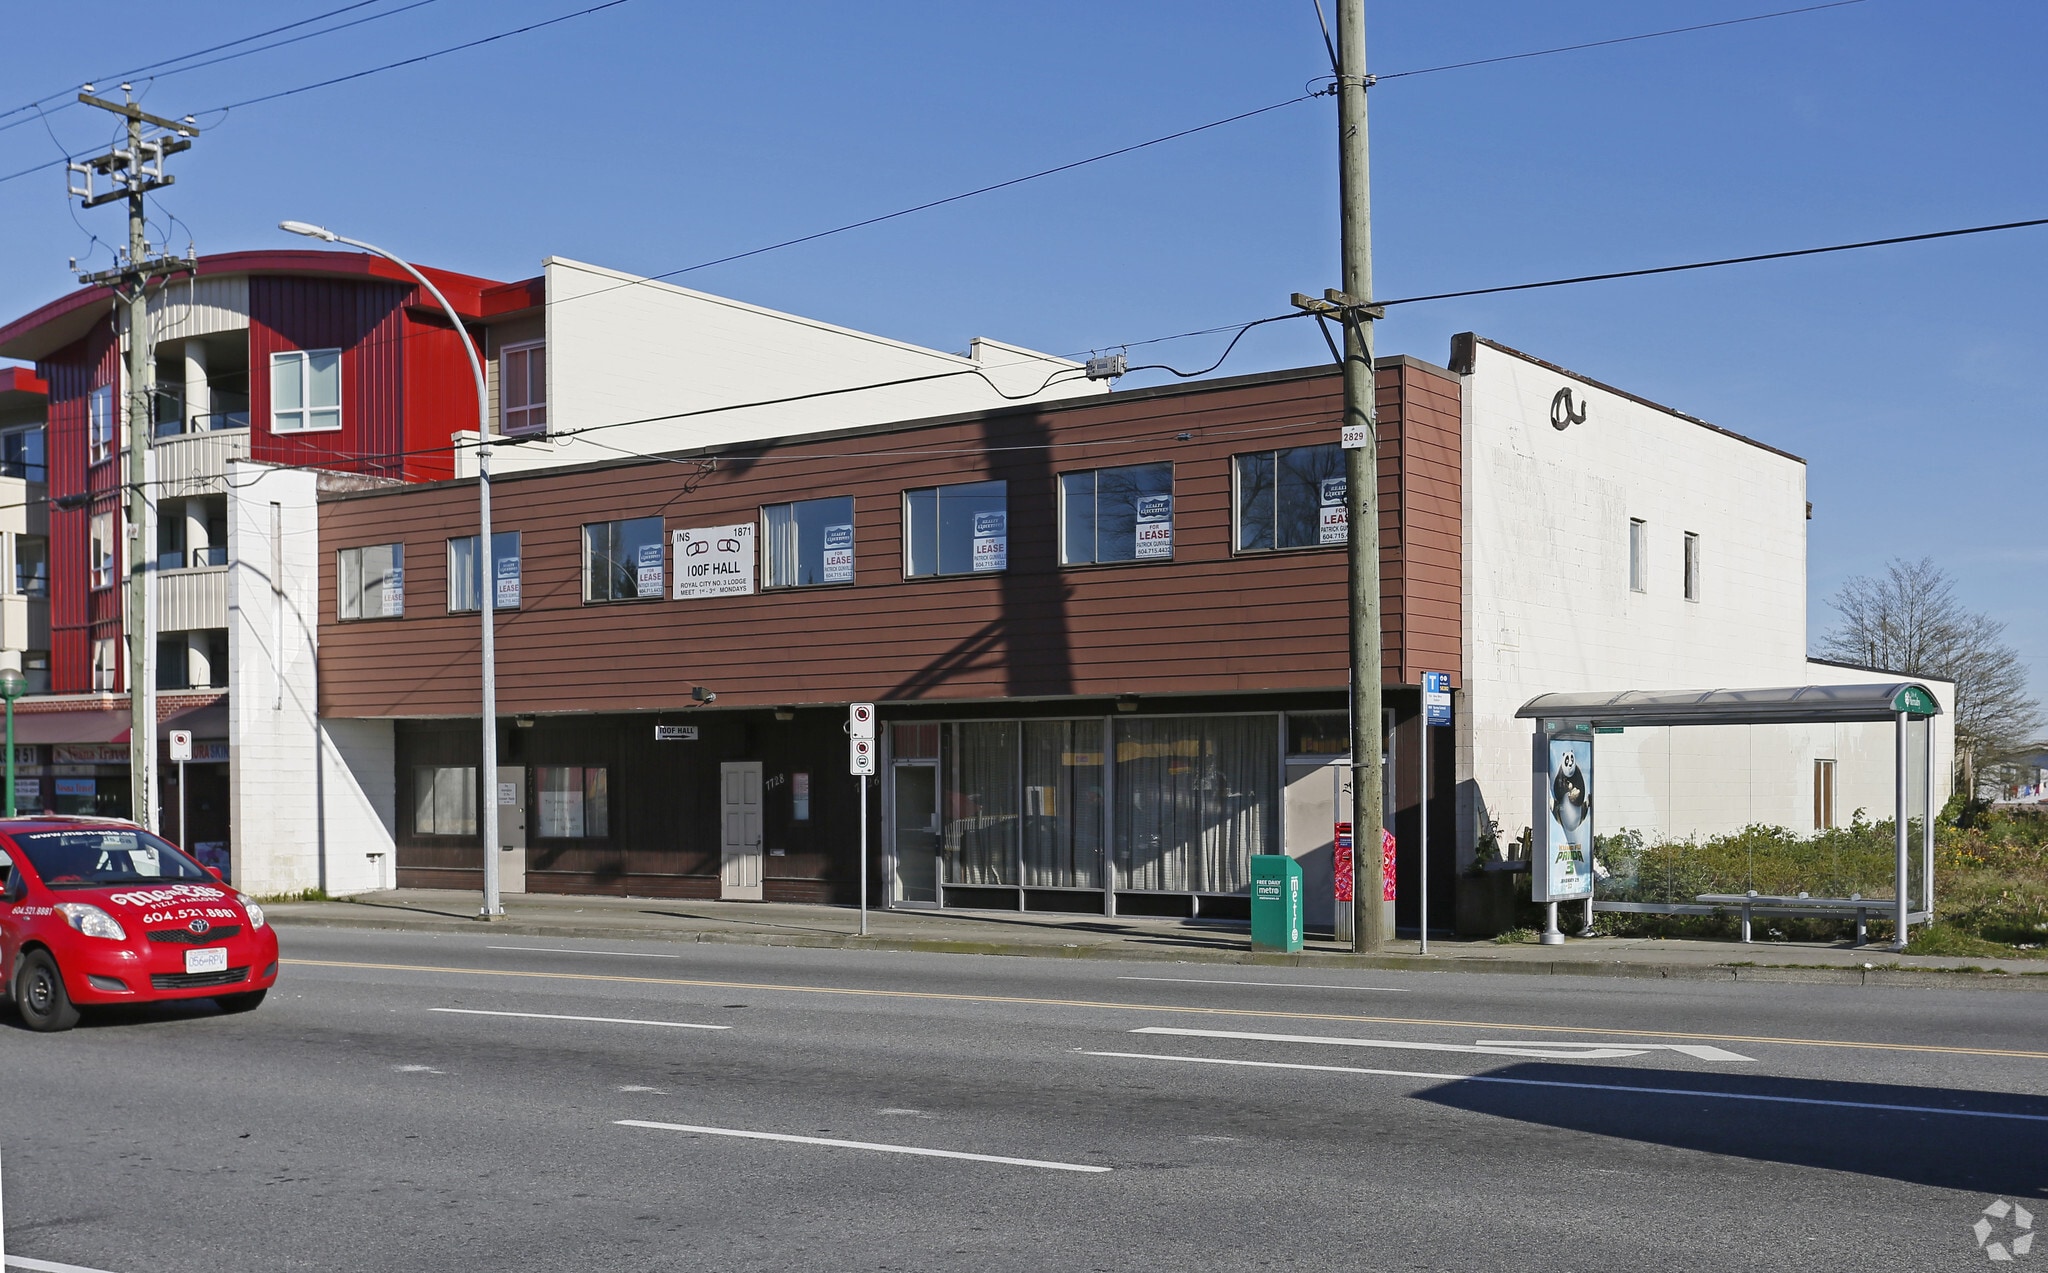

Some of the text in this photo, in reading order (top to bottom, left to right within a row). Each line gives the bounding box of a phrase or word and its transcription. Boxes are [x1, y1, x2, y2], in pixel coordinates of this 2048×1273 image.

[1344, 432, 1364, 441] 2829
[1324, 514, 1348, 524] LEAS
[734, 527, 751, 536] 1871
[1139, 530, 1170, 540] LEASE
[676, 532, 690, 542] INS
[976, 544, 1004, 554] LEASE
[826, 556, 852, 565] LEASE
[712, 561, 740, 574] HALL
[640, 573, 662, 582] LEASE
[500, 584, 519, 592] LEASE
[766, 774, 784, 790] 7728
[854, 776, 880, 793] 726
[1555, 851, 1584, 864] PANDA
[1566, 861, 1574, 875] 3
[150, 900, 180, 910] PIZZA
[1290, 879, 1298, 941] metro
[143, 908, 237, 924] 604.521.8881
